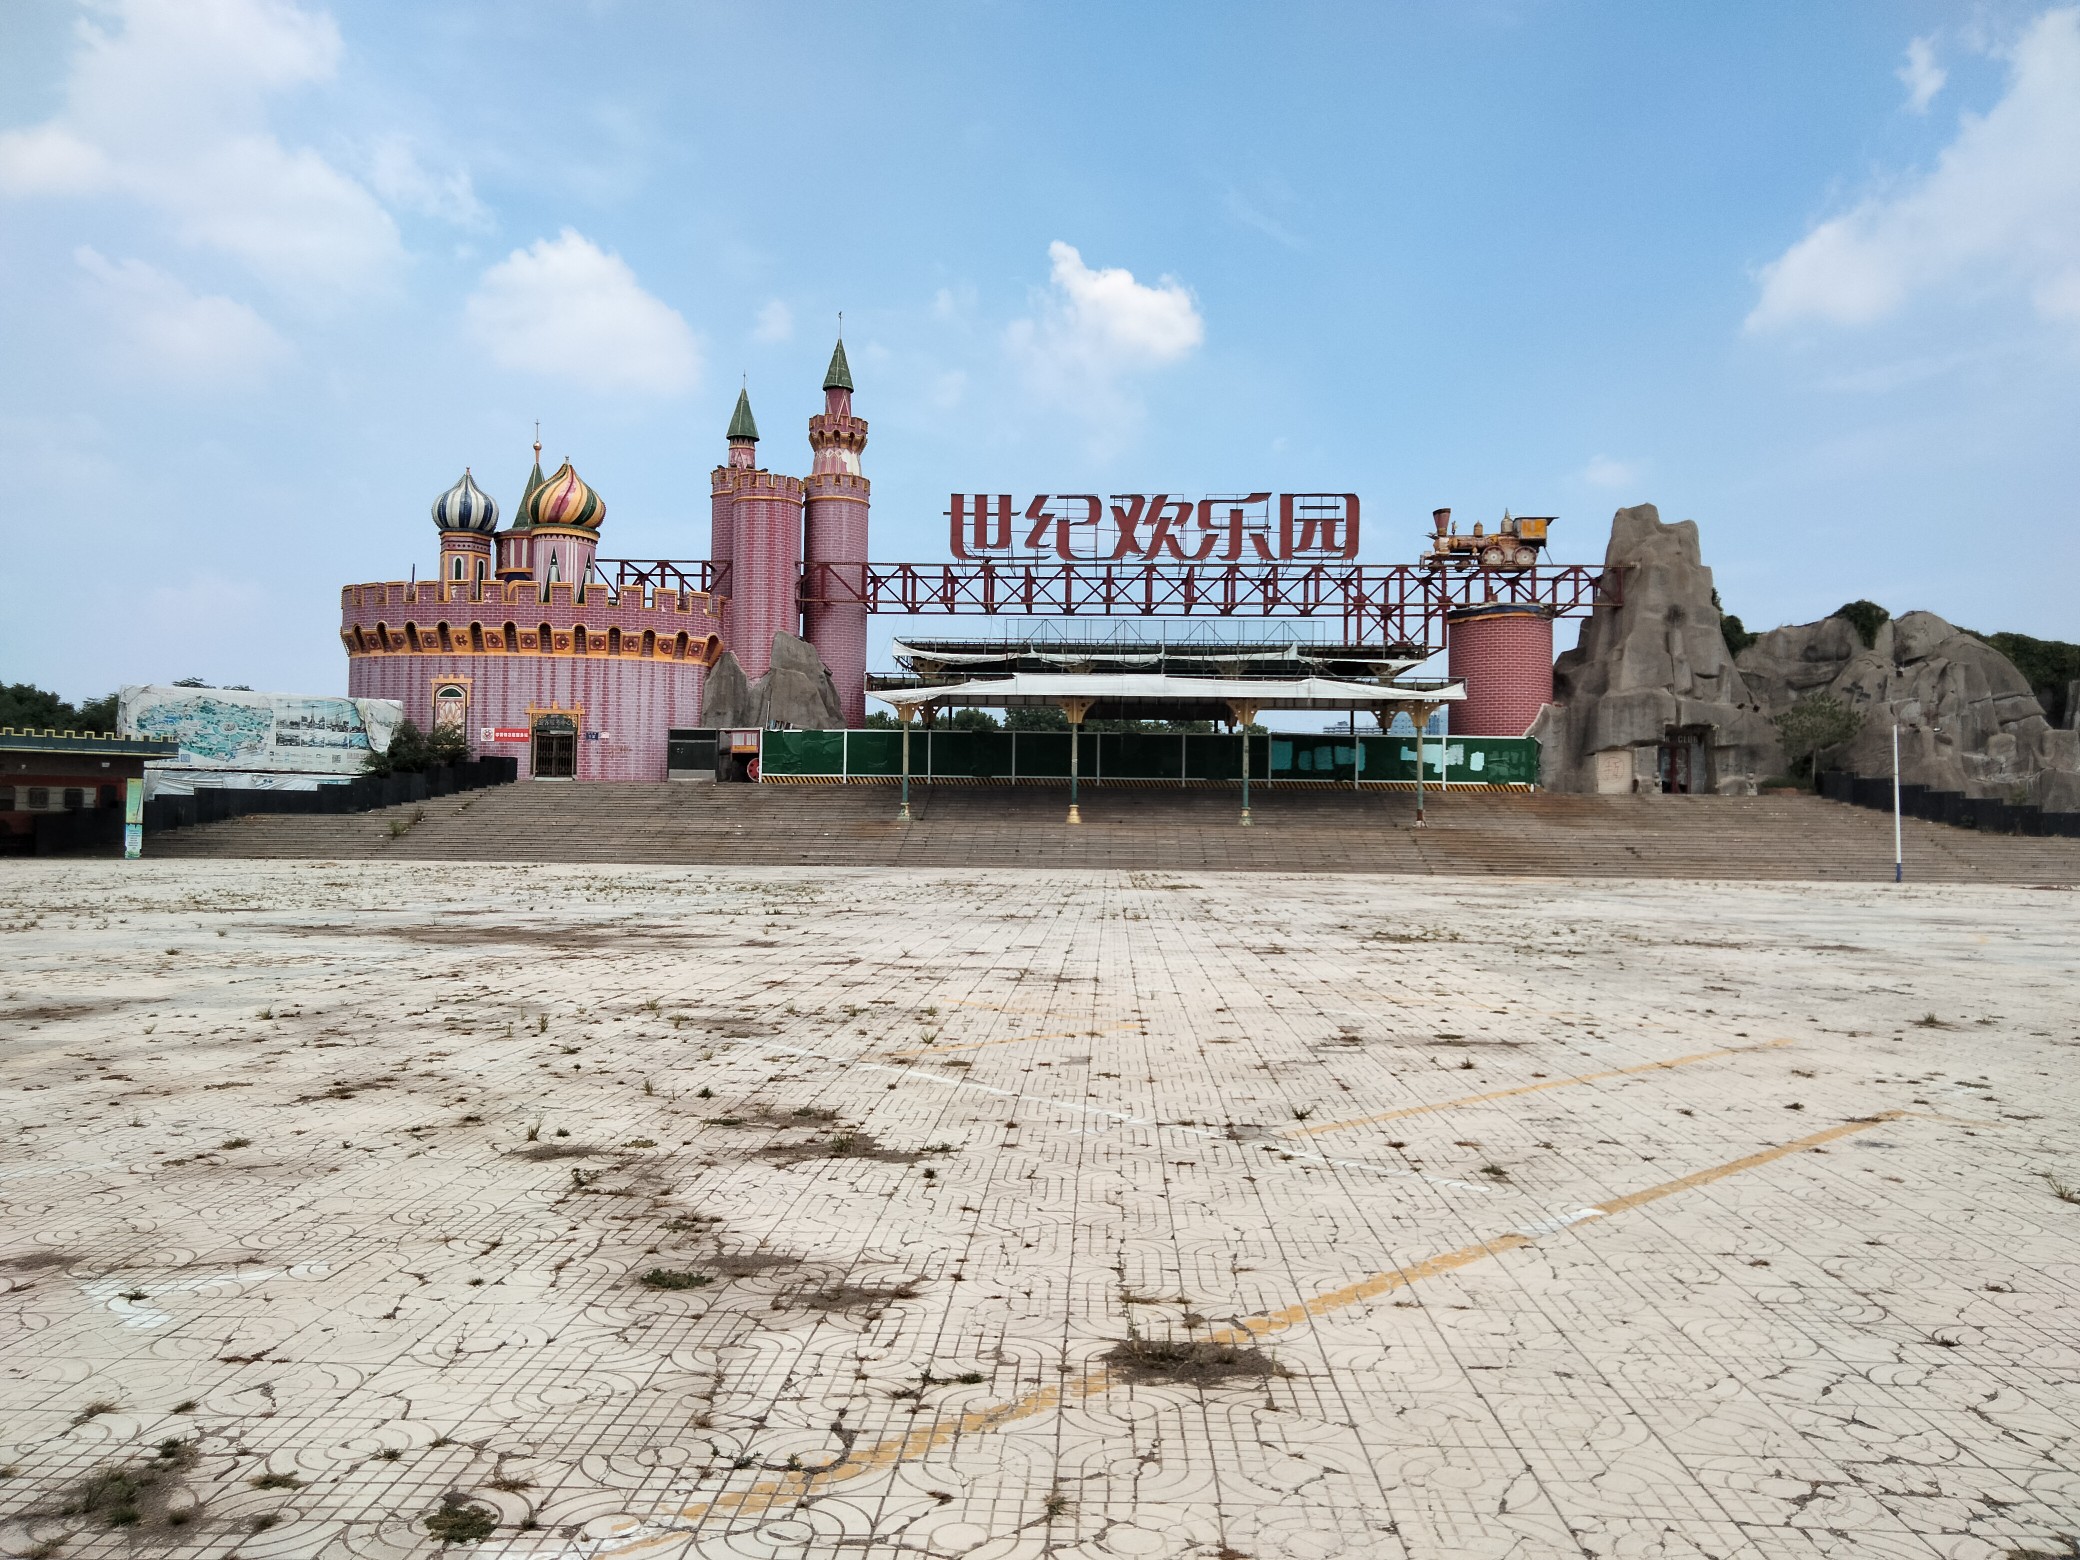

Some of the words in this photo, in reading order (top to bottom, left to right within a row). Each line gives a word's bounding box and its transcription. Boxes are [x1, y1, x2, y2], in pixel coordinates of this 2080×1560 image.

[943, 492, 1360, 561] 世纪欢乐园
